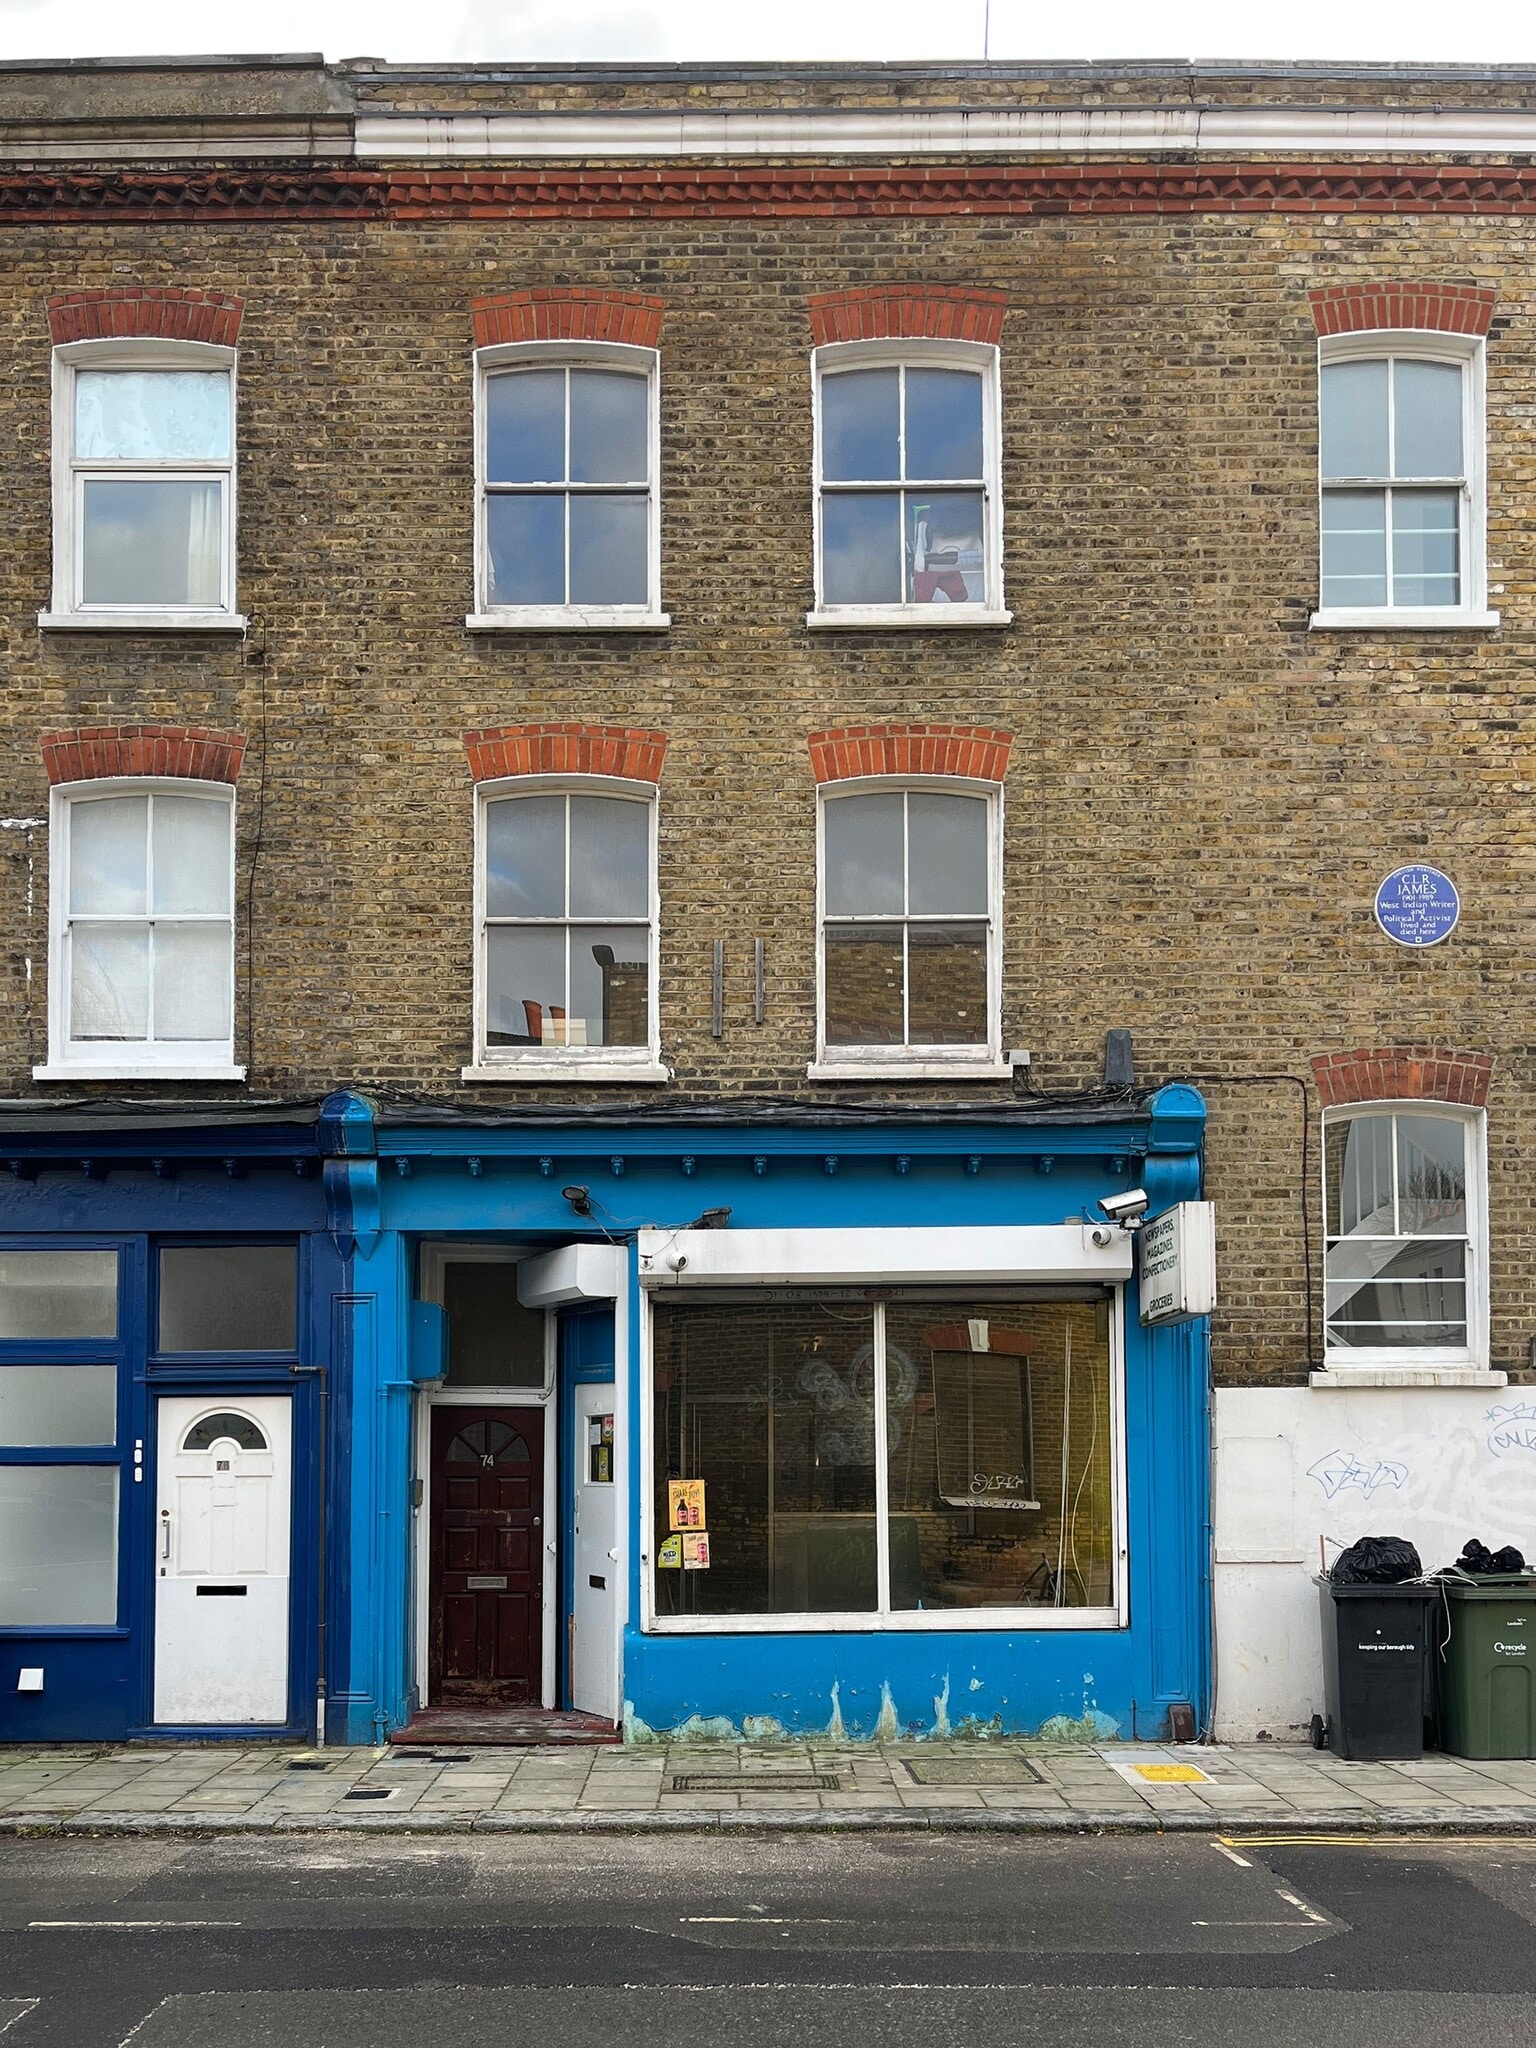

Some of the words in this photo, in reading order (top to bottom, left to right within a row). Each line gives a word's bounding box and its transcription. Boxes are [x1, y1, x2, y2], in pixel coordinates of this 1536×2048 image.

[1393, 868, 1414, 879] ENGLISH
[1416, 867, 1441, 878] HERITAGE
[1397, 884, 1437, 895] JAMES
[1383, 914, 1415, 922] Political
[1146, 1238, 1174, 1261] MAGAZINES
[1142, 1254, 1178, 1280] CONFECTIONERY
[1149, 1292, 1174, 1313] GROCERIES
[480, 1454, 495, 1467] 74
[1505, 1643, 1527, 1652] recycle
